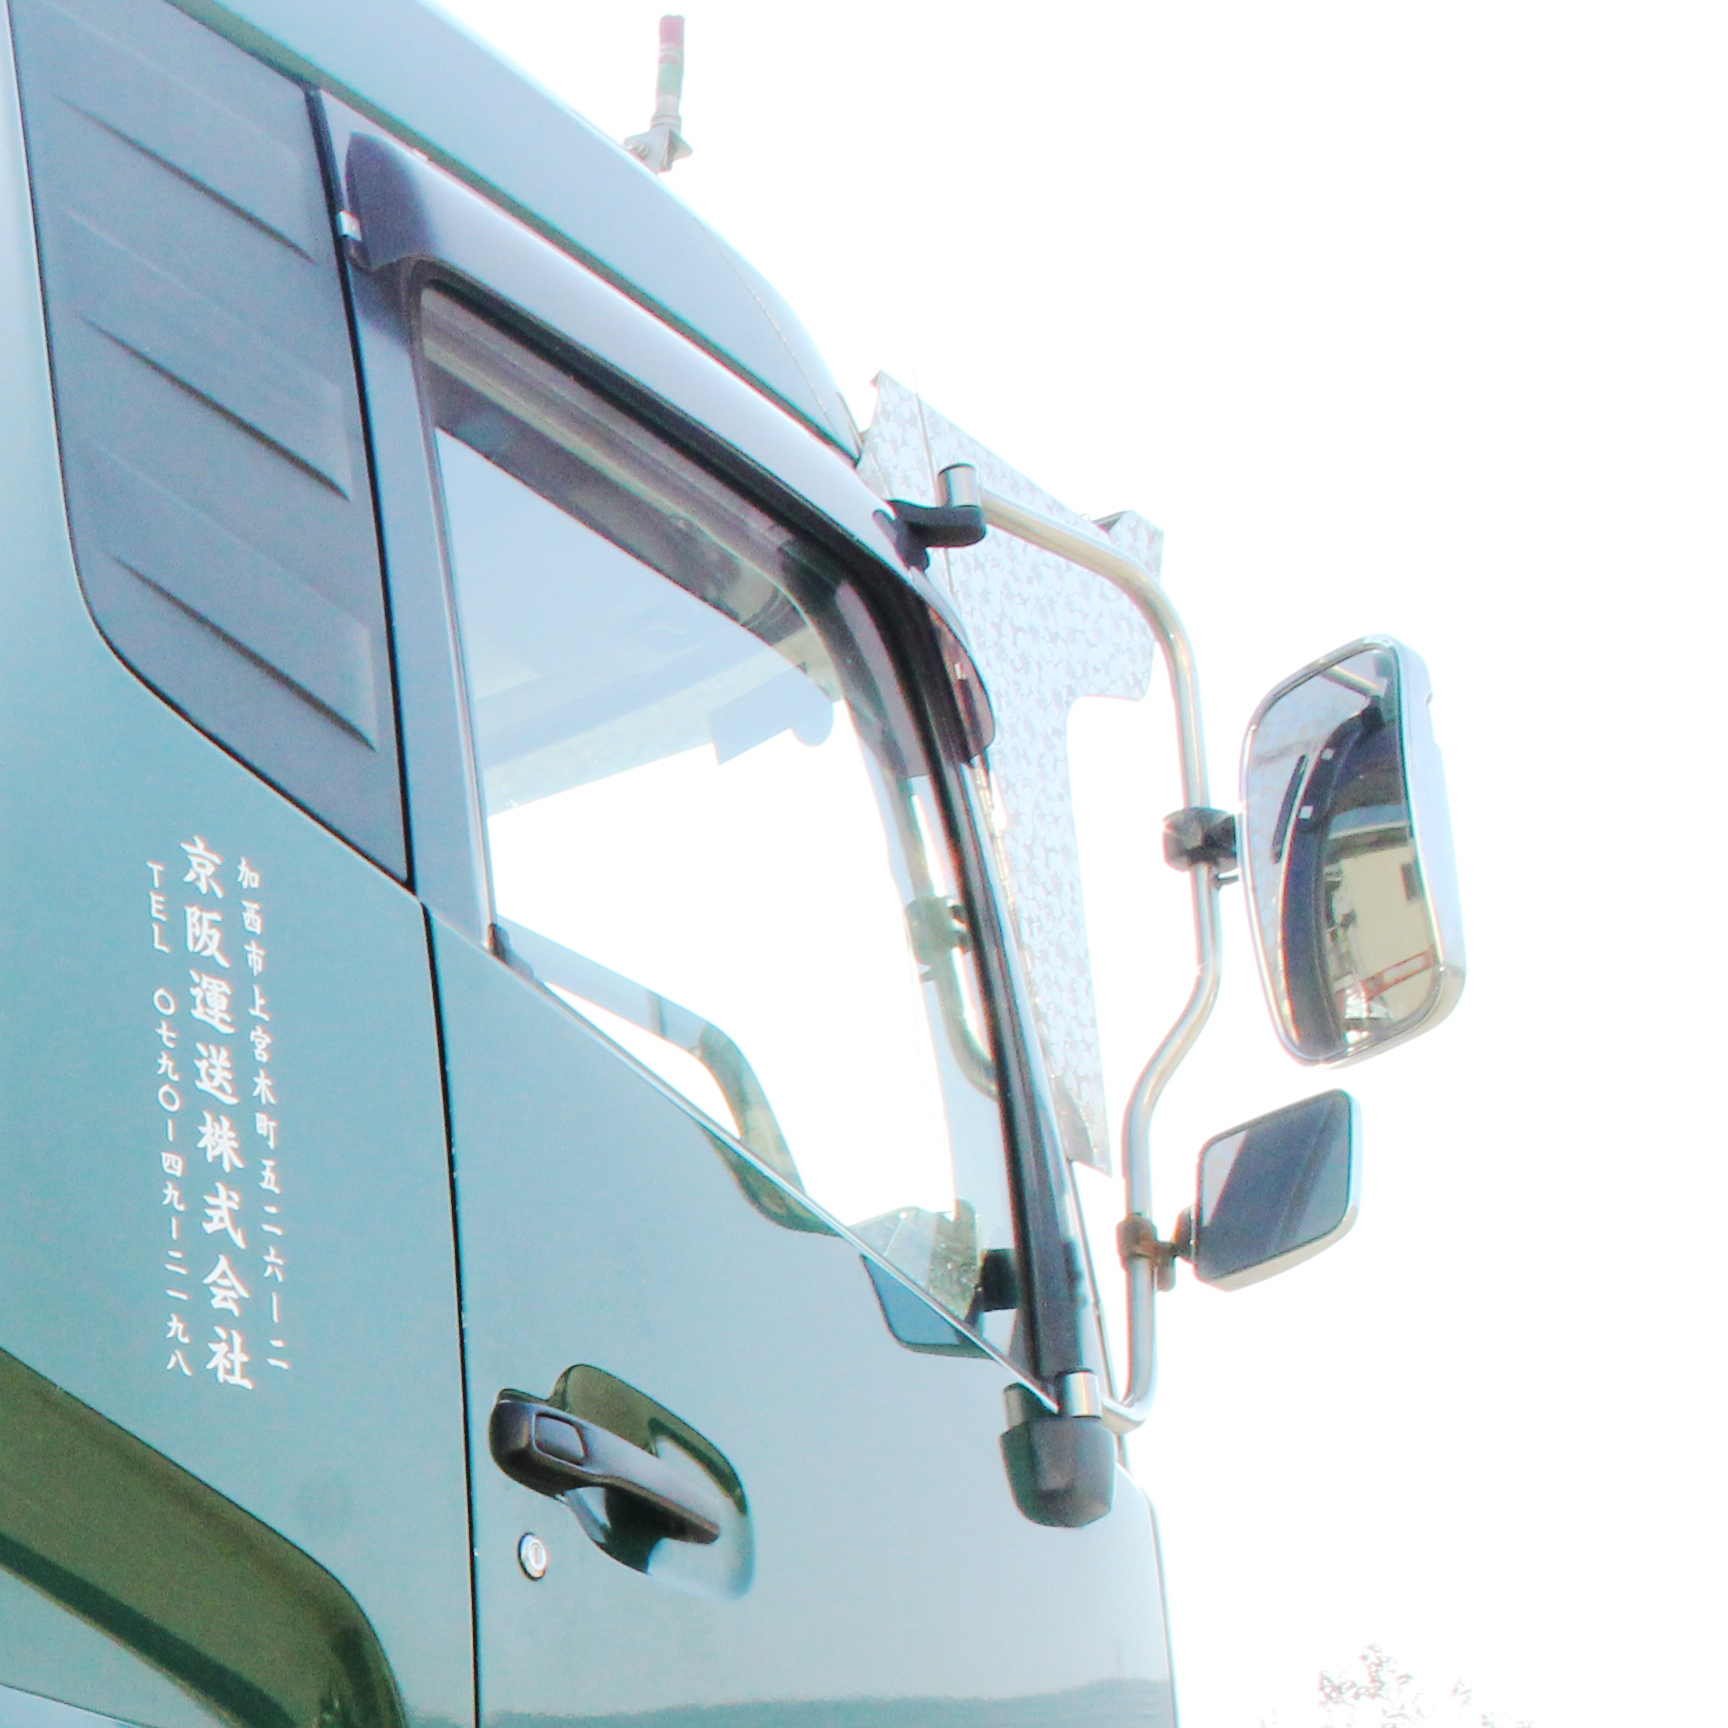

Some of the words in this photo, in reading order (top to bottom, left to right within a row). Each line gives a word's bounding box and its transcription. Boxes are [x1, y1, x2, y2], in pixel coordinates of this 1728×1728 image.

[146, 859, 172, 955] TEL
[180, 834, 255, 1392] 京阪運送株式会社
